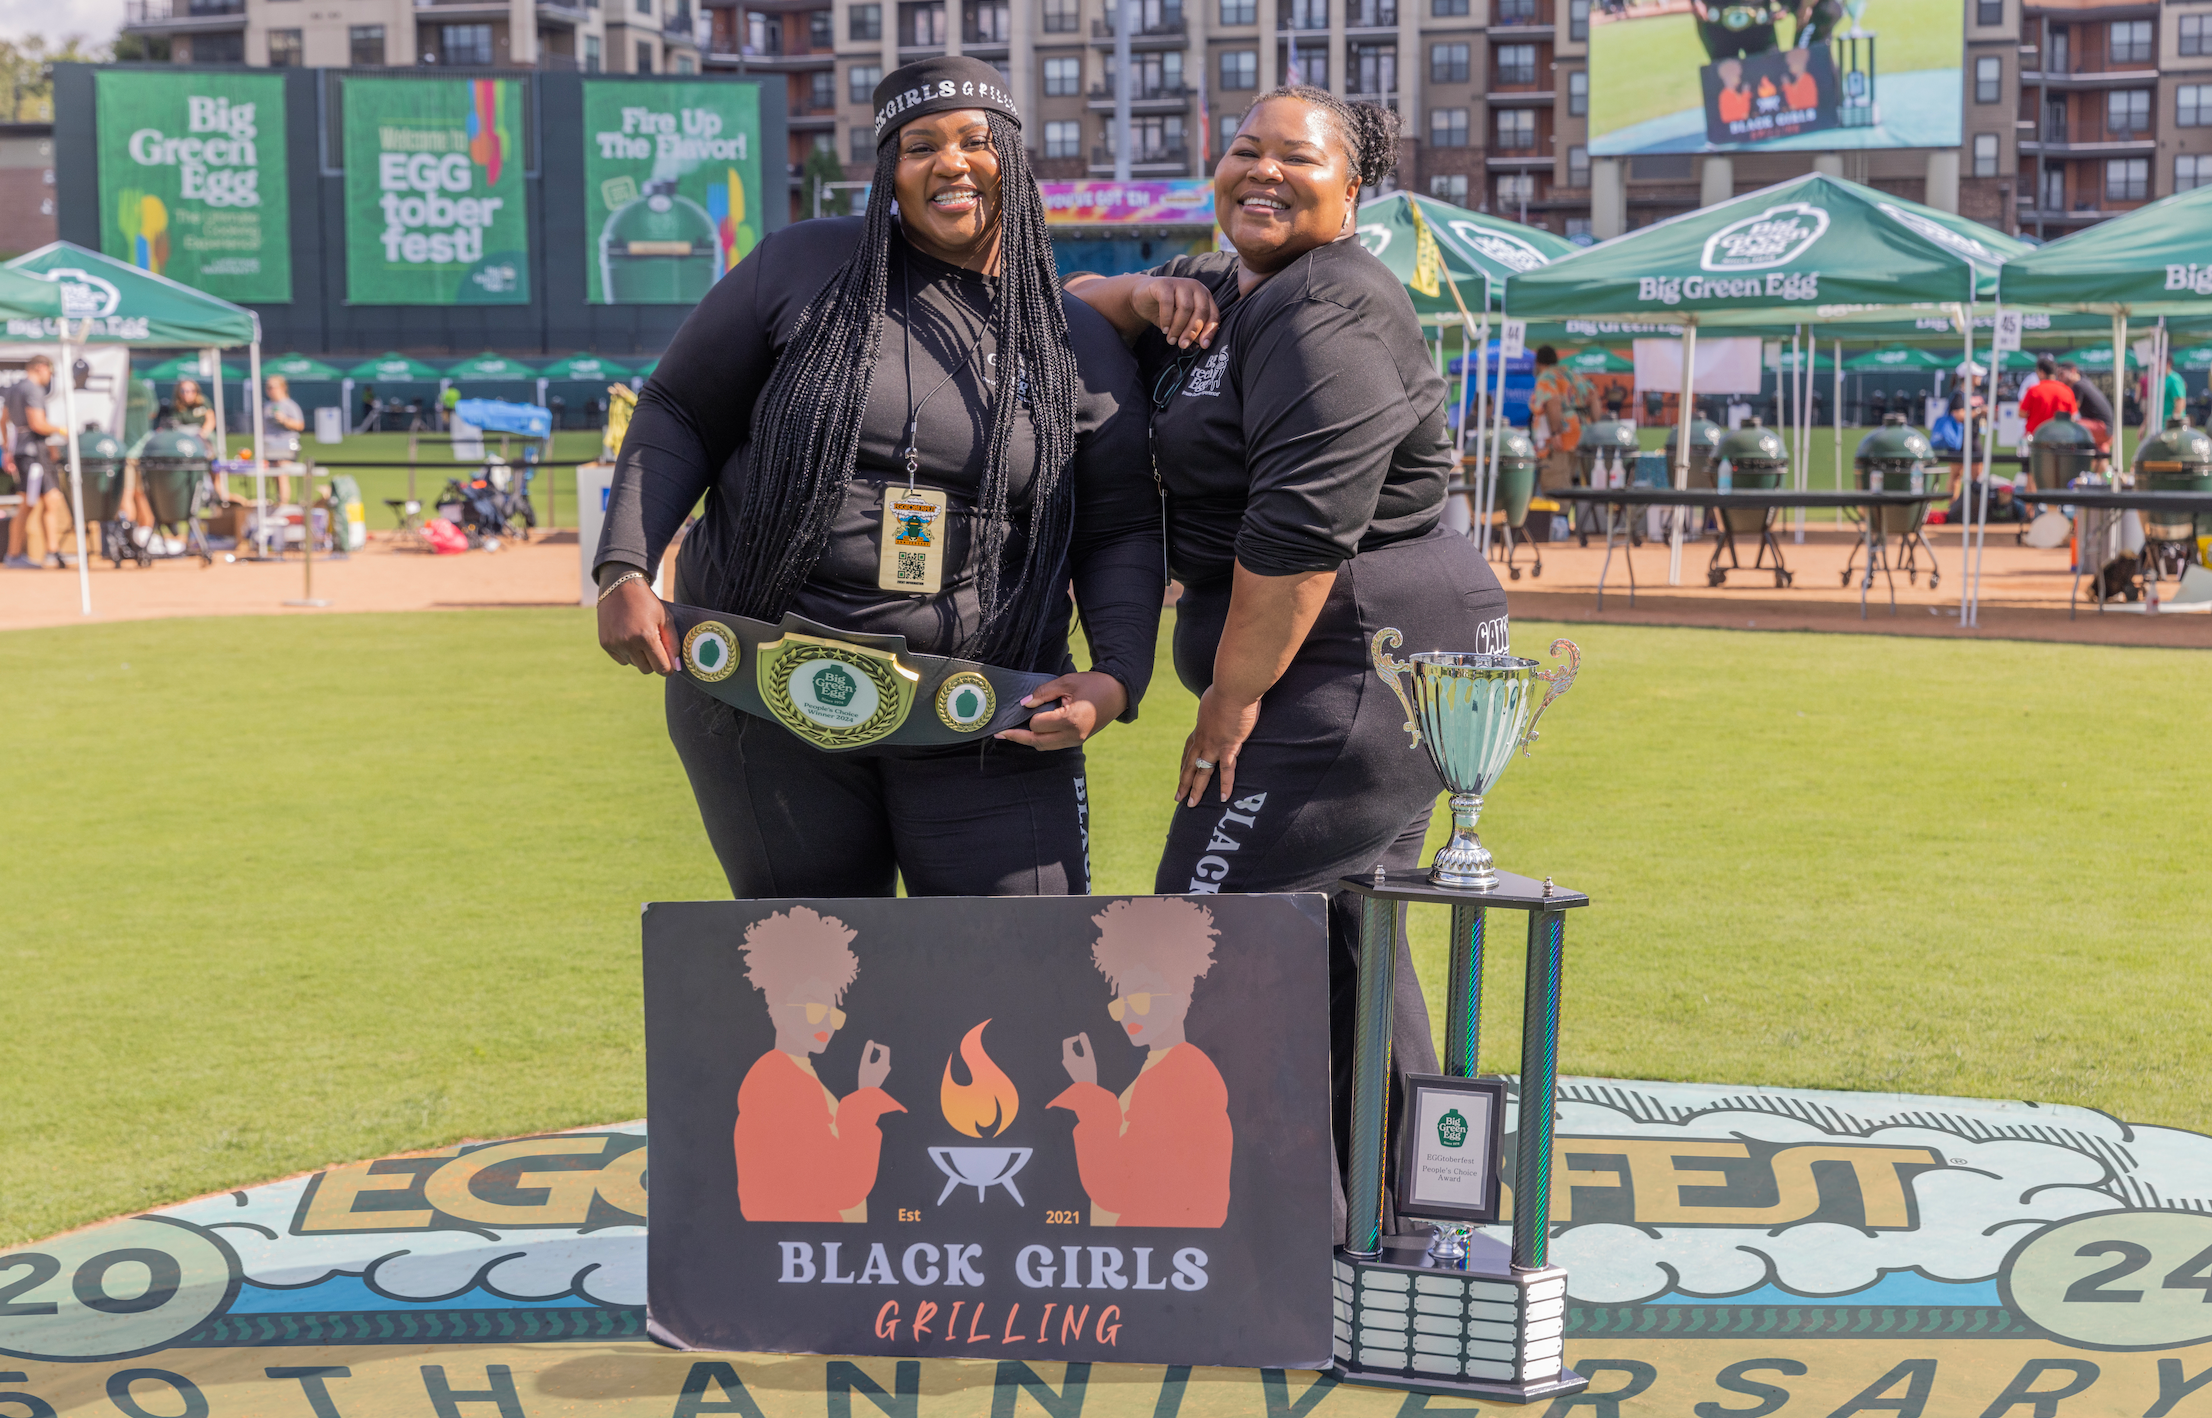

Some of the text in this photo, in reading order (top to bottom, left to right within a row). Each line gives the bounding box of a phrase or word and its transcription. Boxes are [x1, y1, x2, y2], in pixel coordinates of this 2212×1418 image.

[886, 79, 957, 119] GIRLS
[188, 97, 257, 140] Big
[621, 106, 722, 138] Fire Up
[129, 129, 257, 166] Green
[596, 132, 748, 160] The Flavor!
[181, 165, 262, 208] Egg
[379, 154, 470, 191] EGG
[379, 191, 503, 227] tober
[381, 227, 483, 263] fest!
[1638, 270, 1820, 305] Big Green Egg
[2164, 262, 2212, 295] Big
[106, 315, 151, 340] Egg
[1565, 319, 1599, 337] Big
[815, 677, 854, 693] Green
[821, 686, 846, 700] Egg
[825, 672, 846, 686] Big
[804, 702, 859, 718] People's Choice
[807, 708, 854, 723] Winner 2024
[1439, 1122, 1467, 1133] Green
[1445, 1116, 1461, 1127] Big
[1443, 1130, 1461, 1142] Egg
[1422, 1165, 1478, 1177] People's Choice
[1427, 1154, 1475, 1164] EGGtoberfest
[290, 1135, 647, 1235] EG
[1437, 1174, 1461, 1183] Award
[898, 1208, 1080, 1225] Est 2021
[777, 1241, 1209, 1292] BLACK GIRLS
[2063, 1239, 2212, 1304] 24
[874, 1299, 1123, 1347] GRILLING
